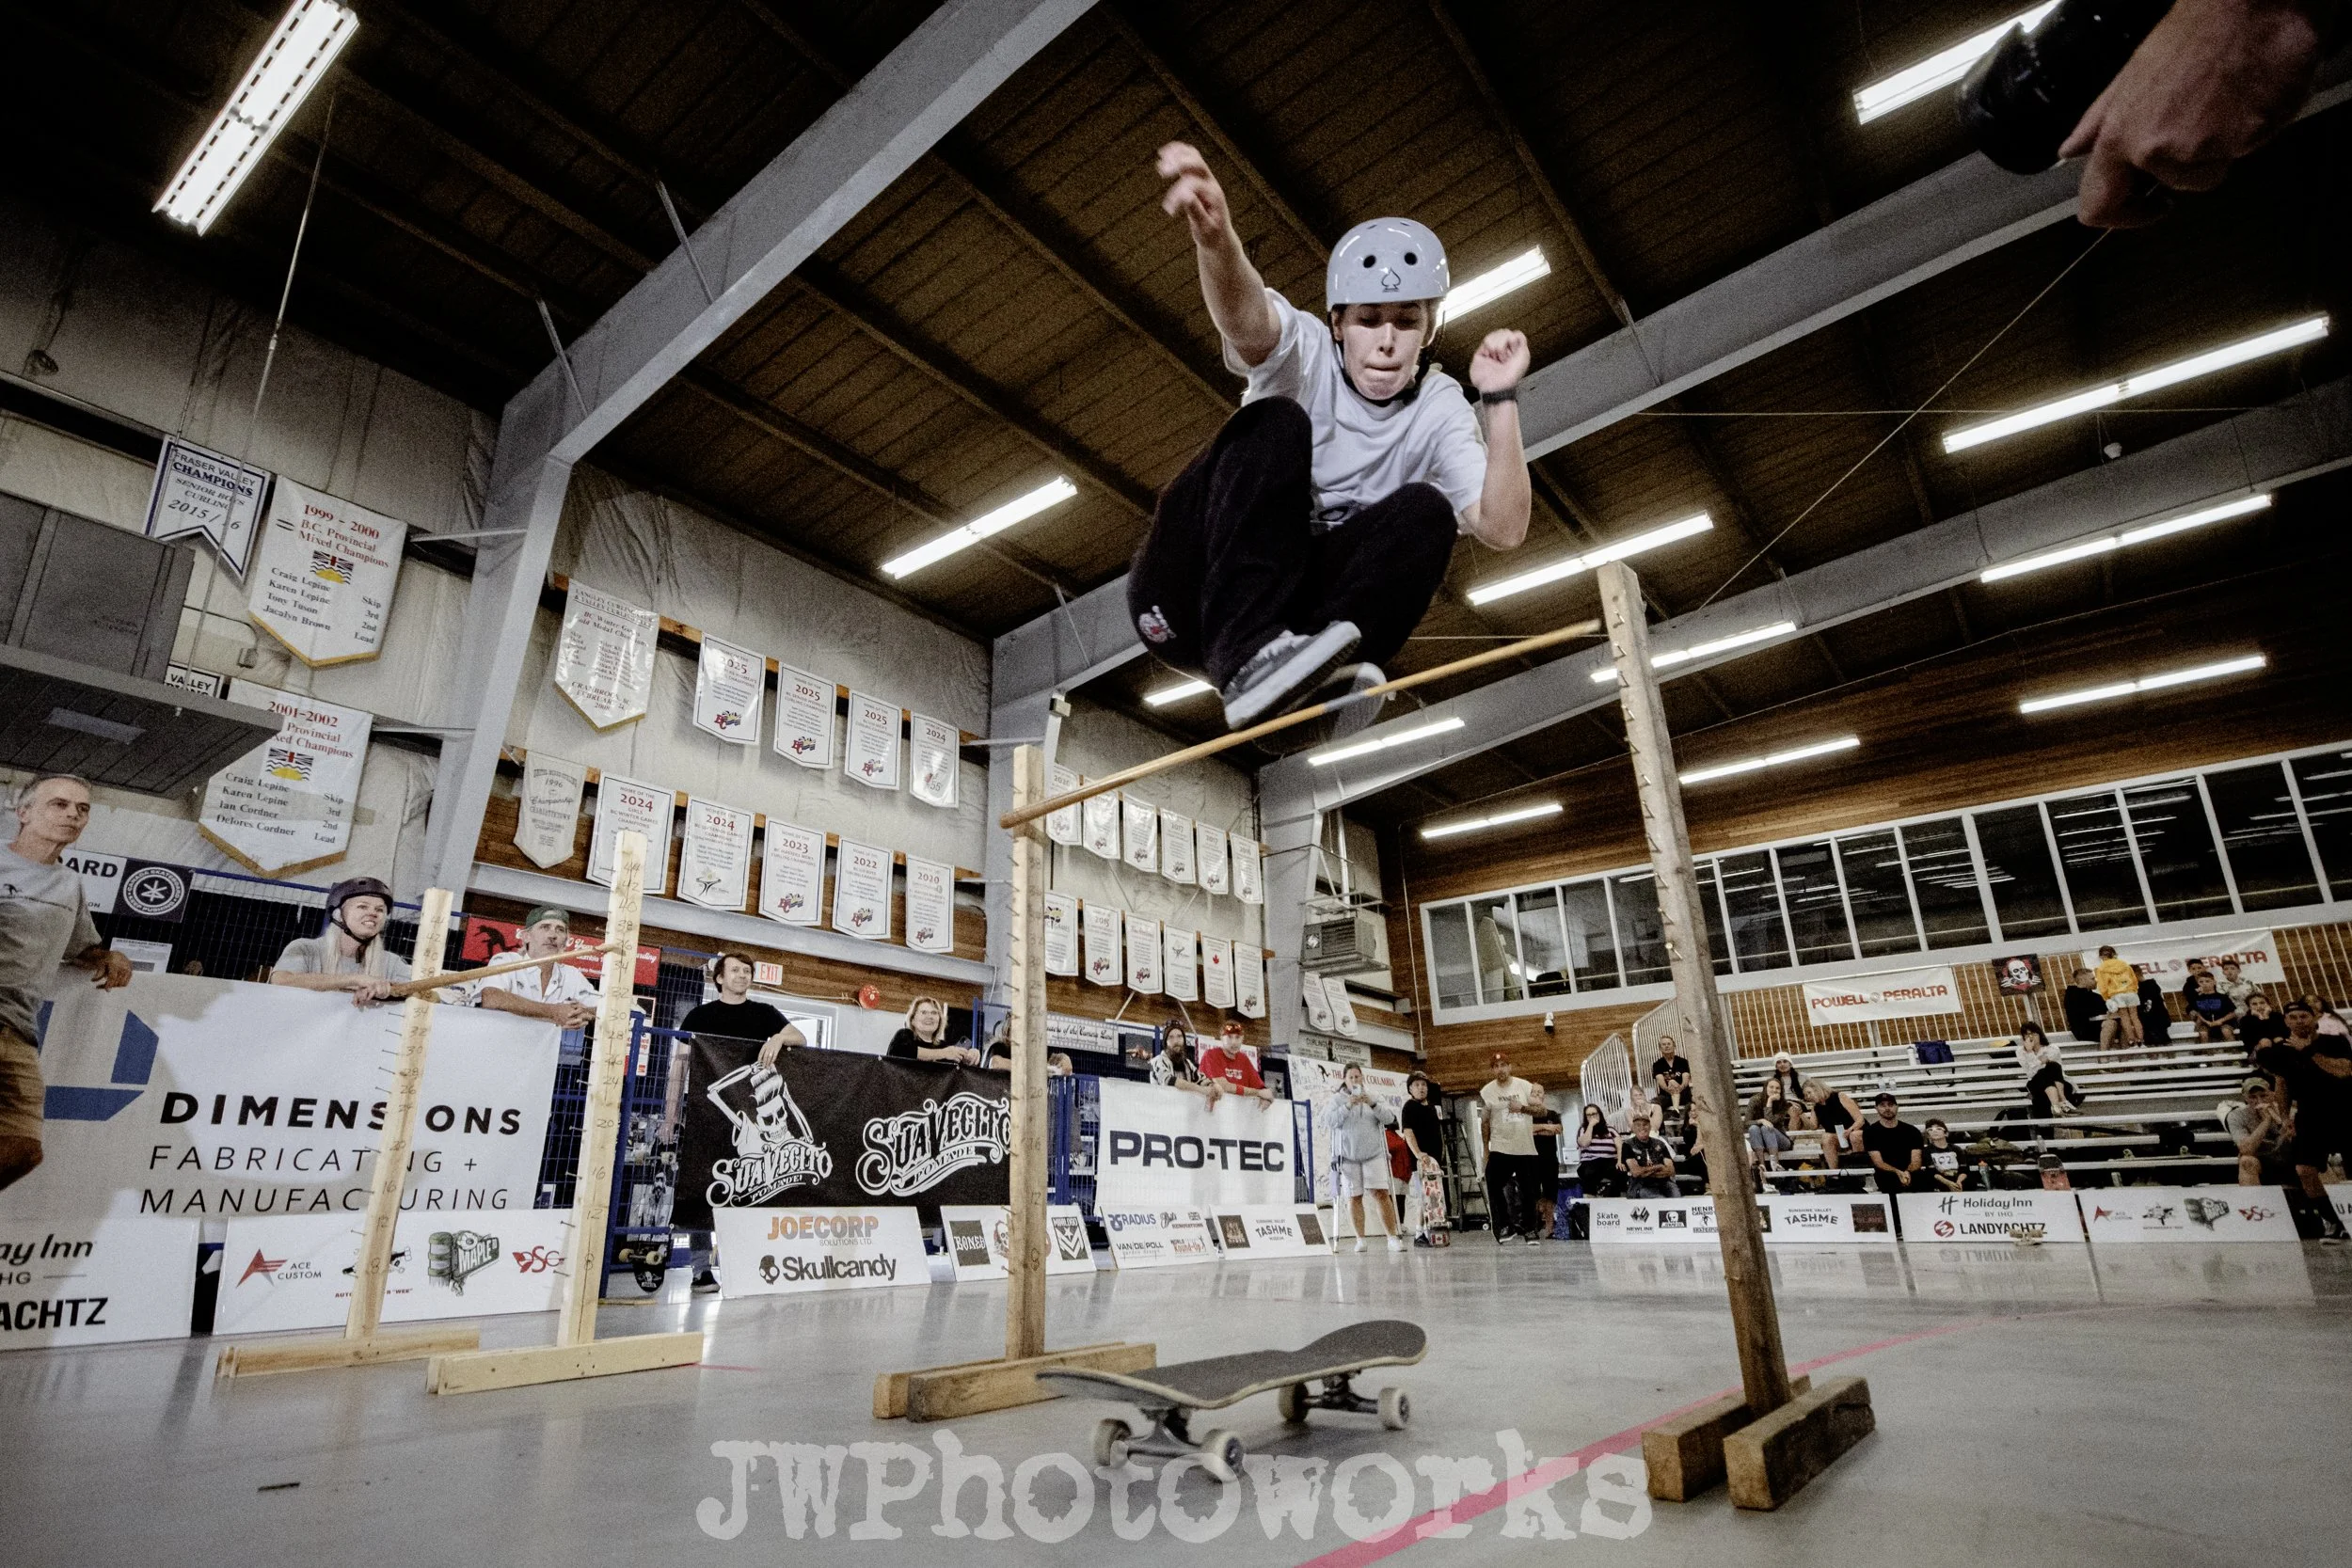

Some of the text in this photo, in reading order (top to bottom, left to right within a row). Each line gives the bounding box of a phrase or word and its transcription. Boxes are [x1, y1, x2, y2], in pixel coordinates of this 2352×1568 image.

[175, 451, 256, 486] FRASER VALEY
[173, 462, 254, 497] CHAMPIONS
[176, 478, 245, 506] SENIOR BOS
[304, 504, 380, 540] 1999 2000
[301, 519, 377, 553] B.C. Provincial
[298, 531, 389, 568] Mixed Champions
[271, 567, 298, 582] Craig
[269, 579, 297, 594] Karen
[170, 673, 212, 690] VALEY
[795, 684, 820, 702] 2025
[267, 701, 339, 728] 2001-2002
[865, 709, 888, 725] 2025
[287, 722, 341, 742] Provincial
[926, 727, 946, 743] 2024
[296, 736, 354, 759] Champions
[226, 772, 290, 794] Craig Lepine
[545, 778, 564, 789] 1996
[222, 786, 289, 807] Karen Lepine
[620, 793, 654, 813] 2024
[706, 814, 736, 832] 2024
[783, 838, 810, 854] 2023
[853, 856, 878, 869] 2022
[619, 900, 637, 912] 40
[759, 963, 779, 982] EXIT
[1811, 984, 1948, 1009] POWELL PERALTA
[611, 1010, 627, 1022] 30
[160, 1091, 521, 1136] DIMENSONS
[596, 1118, 614, 1128] 20
[707, 1137, 834, 1208] SUAVECITO
[913, 1145, 976, 1183] POMADE
[750, 1174, 803, 1203] POMADE
[140, 1187, 508, 1215] MANUFACURING
[1963, 1197, 2033, 1210] Holiday Inn
[587, 1209, 600, 1220] 12
[1123, 1213, 1156, 1225] RADIUS
[1597, 1218, 1620, 1227] board
[1785, 1213, 1838, 1226] TASHME
[767, 1215, 880, 1241] JOECORP
[1255, 1225, 1294, 1237] TASHME
[40, 1233, 94, 1259] Inn
[818, 1238, 858, 1247] SOLUTIONS
[953, 1236, 986, 1252] BONES
[1116, 1243, 1133, 1251] VAN
[291, 1261, 312, 1272] ACE
[458, 1242, 491, 1274] MAPLE
[278, 1271, 323, 1281] CUSTOM
[782, 1253, 897, 1282] Skullcandy
